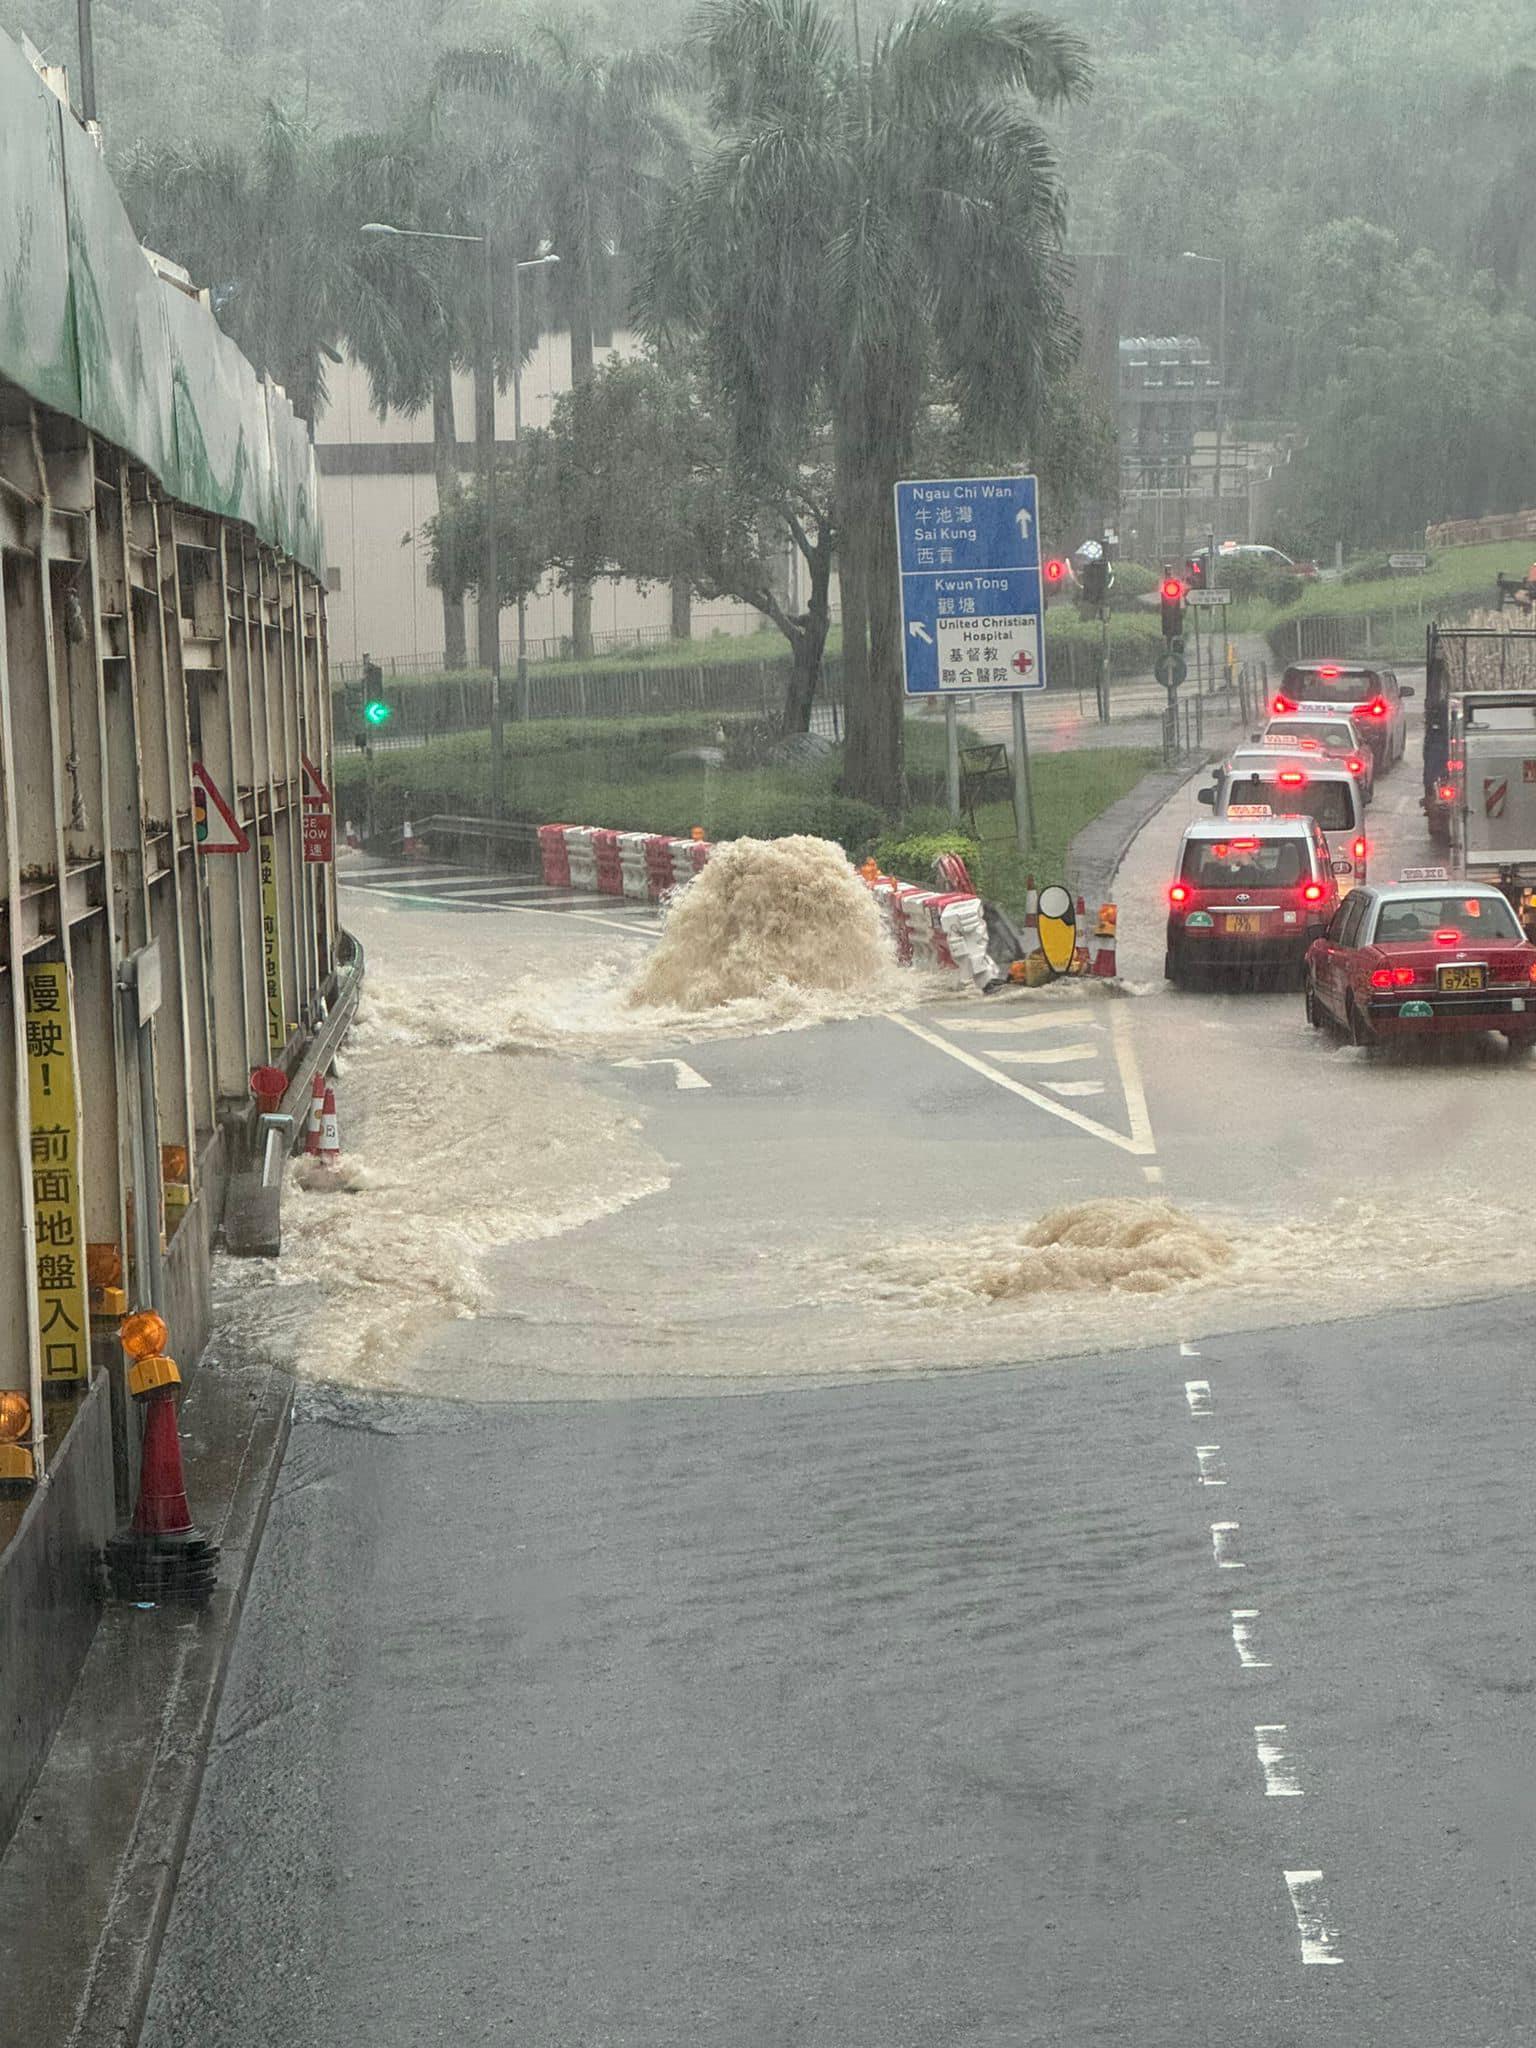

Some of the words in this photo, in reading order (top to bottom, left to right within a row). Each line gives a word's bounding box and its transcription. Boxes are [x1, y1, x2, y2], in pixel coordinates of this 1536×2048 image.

[913, 488, 950, 502] Ngau
[954, 486, 977, 498] Chi
[981, 485, 1012, 498] Wan
[915, 505, 973, 526] 牛池灣
[914, 528, 937, 541] Sai
[940, 527, 977, 542] Kung
[916, 546, 954, 565] 西貢
[935, 578, 973, 591] Kwun
[974, 577, 1008, 591] Tong
[937, 597, 975, 615] 觀塘
[939, 619, 979, 630] United
[982, 617, 1035, 628] Christian
[963, 630, 1014, 642] Hospital
[949, 646, 998, 662] 基督教
[942, 667, 1008, 683] 聯合醫院
[1445, 977, 1479, 989] 9745
